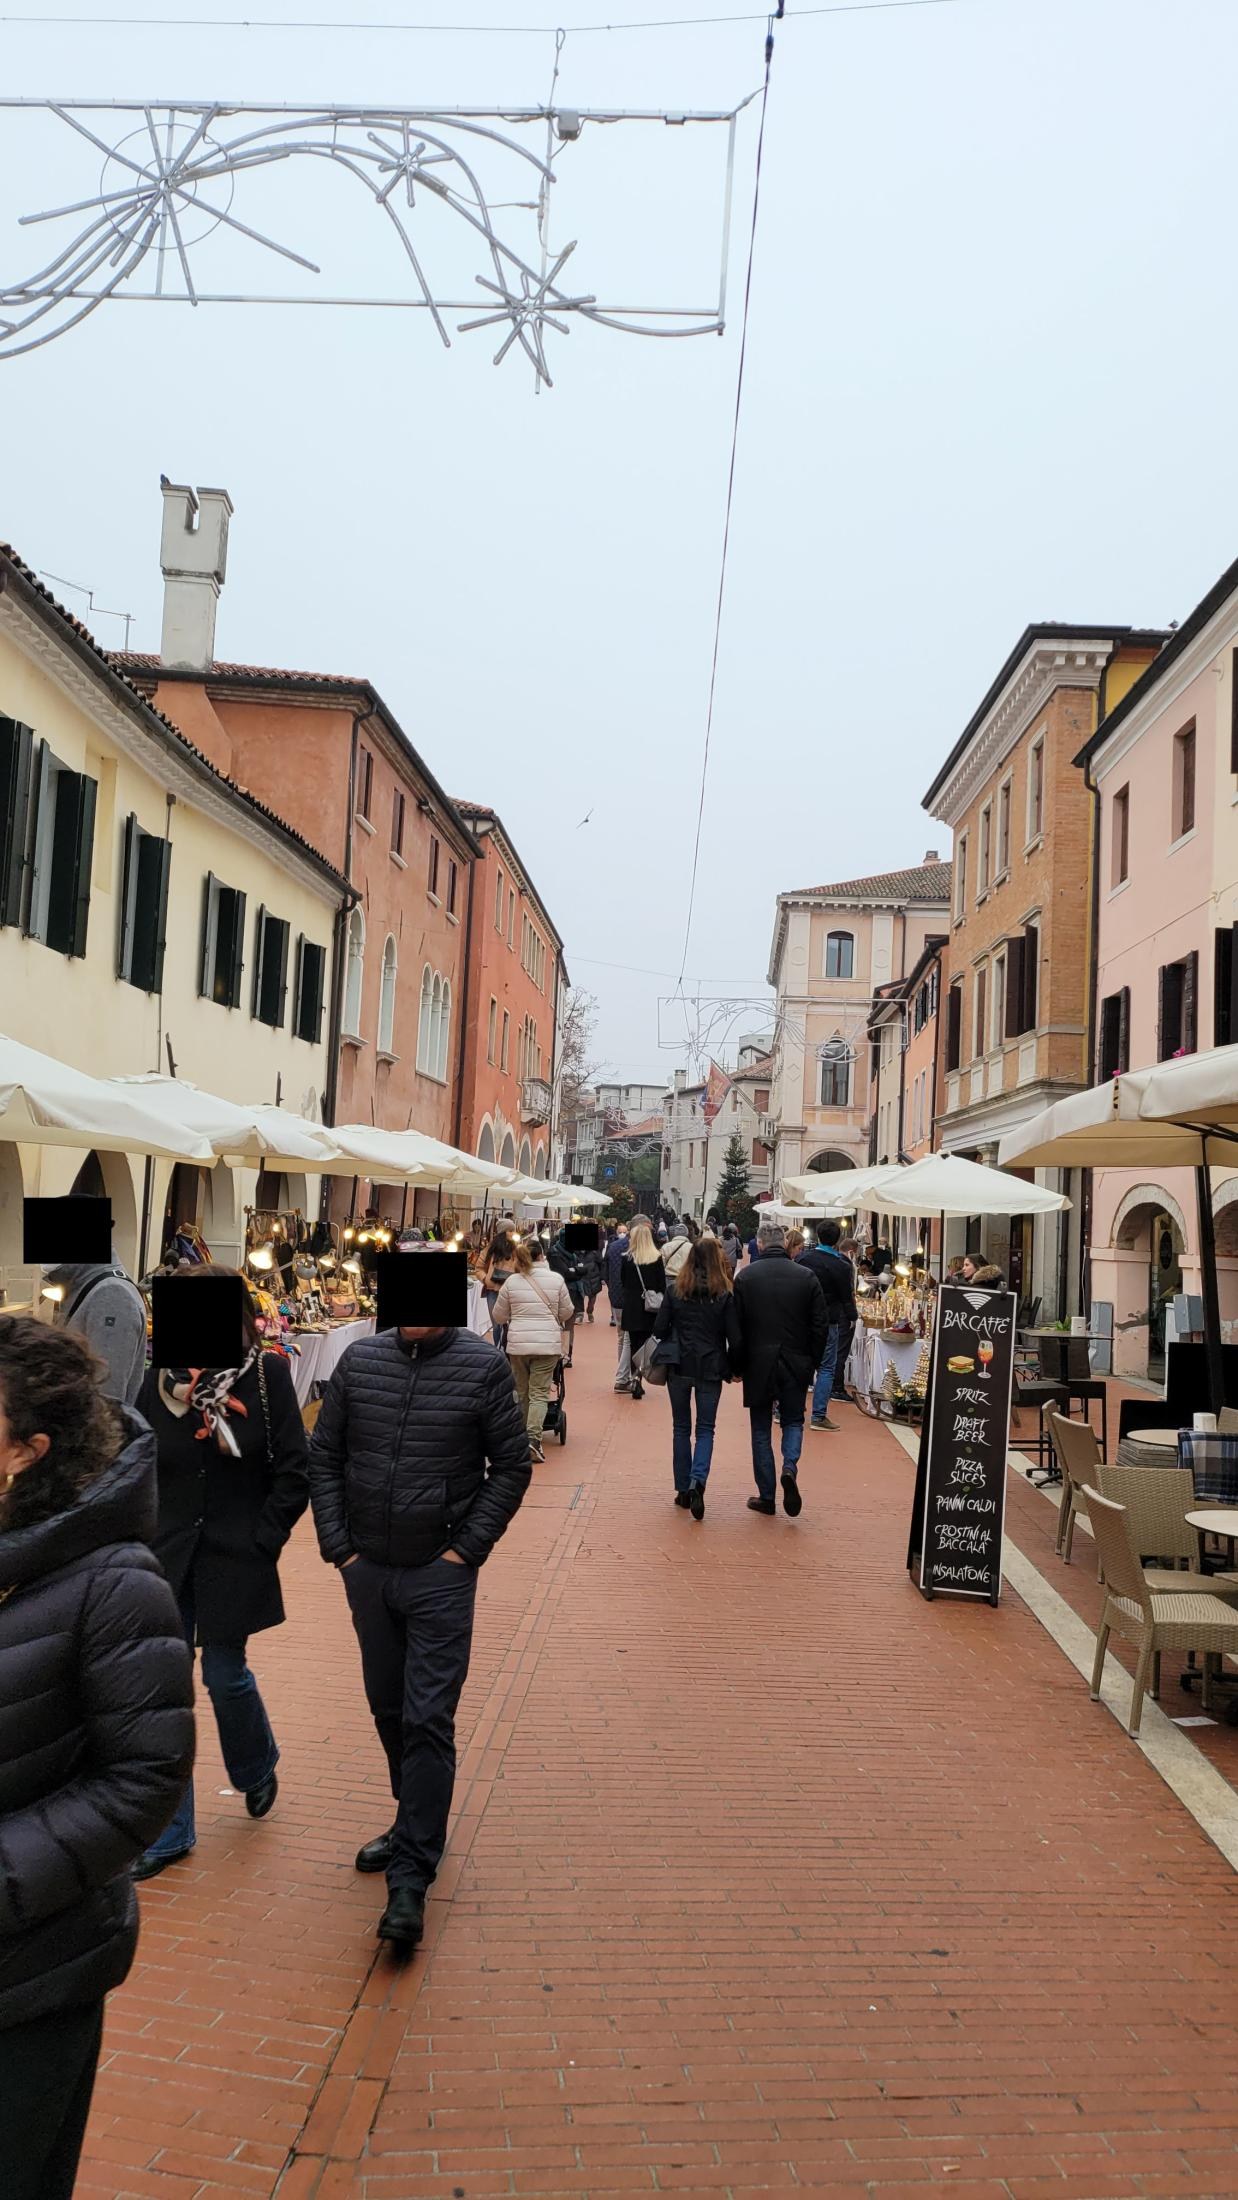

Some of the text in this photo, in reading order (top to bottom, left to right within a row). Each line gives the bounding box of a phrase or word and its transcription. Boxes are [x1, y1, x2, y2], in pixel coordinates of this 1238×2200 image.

[942, 1309, 970, 1331] BAR
[950, 1387, 992, 1406] SPRITZ
[952, 1414, 990, 1431] DRAFT
[952, 1430, 992, 1447] BEER
[954, 1457, 984, 1474] PIZZA
[945, 1470, 987, 1489] SLICES
[936, 1493, 996, 1515] PANINI CALDI
[934, 1524, 992, 1542] CROSTINI AL
[932, 1562, 991, 1583] INSALATONE
